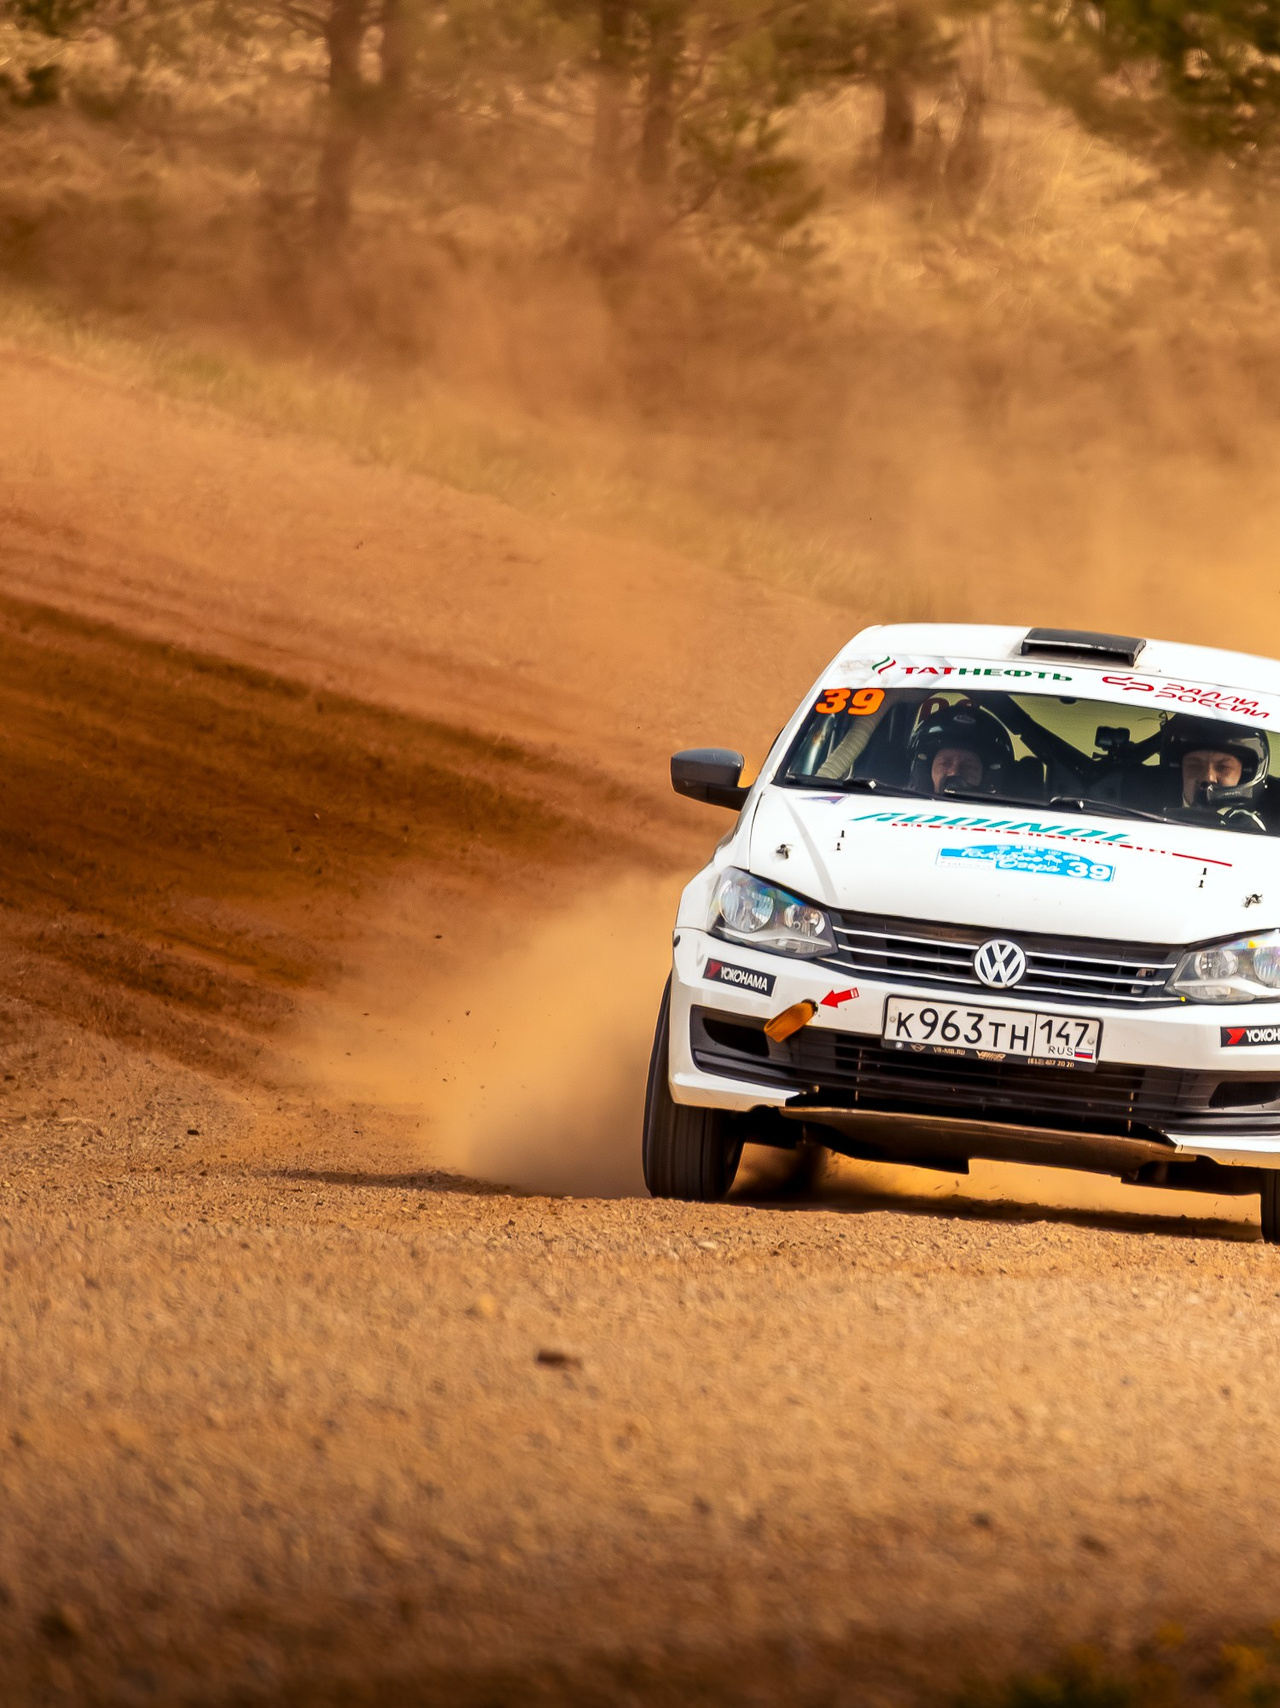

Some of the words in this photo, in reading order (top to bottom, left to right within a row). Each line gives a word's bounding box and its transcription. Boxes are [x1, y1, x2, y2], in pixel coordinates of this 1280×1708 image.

[901, 666, 1073, 682] ТАТНЕФТЬ
[815, 687, 885, 716] 39
[1154, 690, 1270, 719] РОССИИ
[849, 812, 1131, 844] ADDINOL
[1066, 861, 1111, 881] 39
[720, 966, 768, 991] YOKOHAMA
[1039, 1018, 1090, 1048] 147
[1048, 1045, 1074, 1057] RUS
